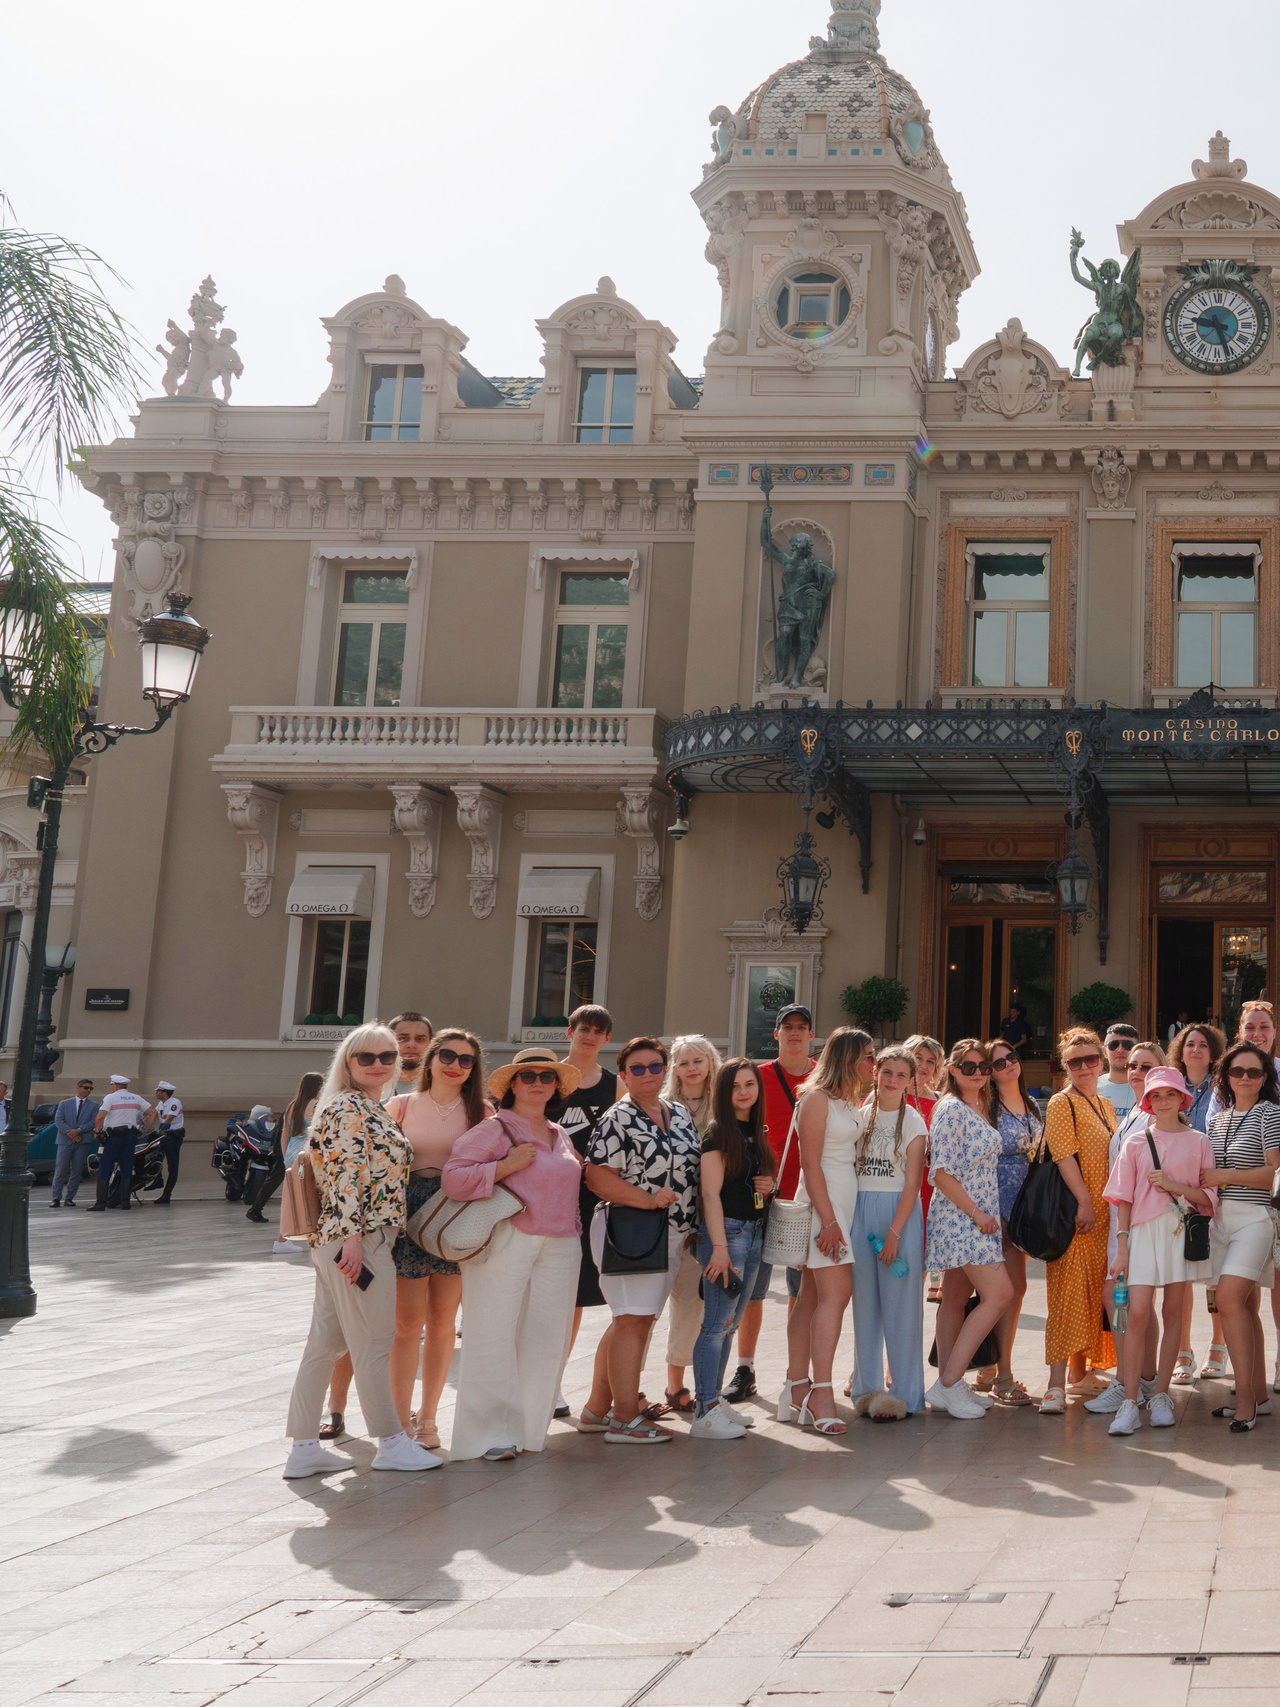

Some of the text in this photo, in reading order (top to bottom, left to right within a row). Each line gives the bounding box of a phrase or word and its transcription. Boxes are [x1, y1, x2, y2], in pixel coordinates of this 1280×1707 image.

[1165, 719, 1238, 730] CASINO
[302, 904, 337, 913] OMEGA
[532, 905, 568, 914] OMEGA
[309, 1030, 344, 1039] OMEGA
[538, 1031, 568, 1041] OMEG
[857, 1166, 895, 1178] PASTIME
